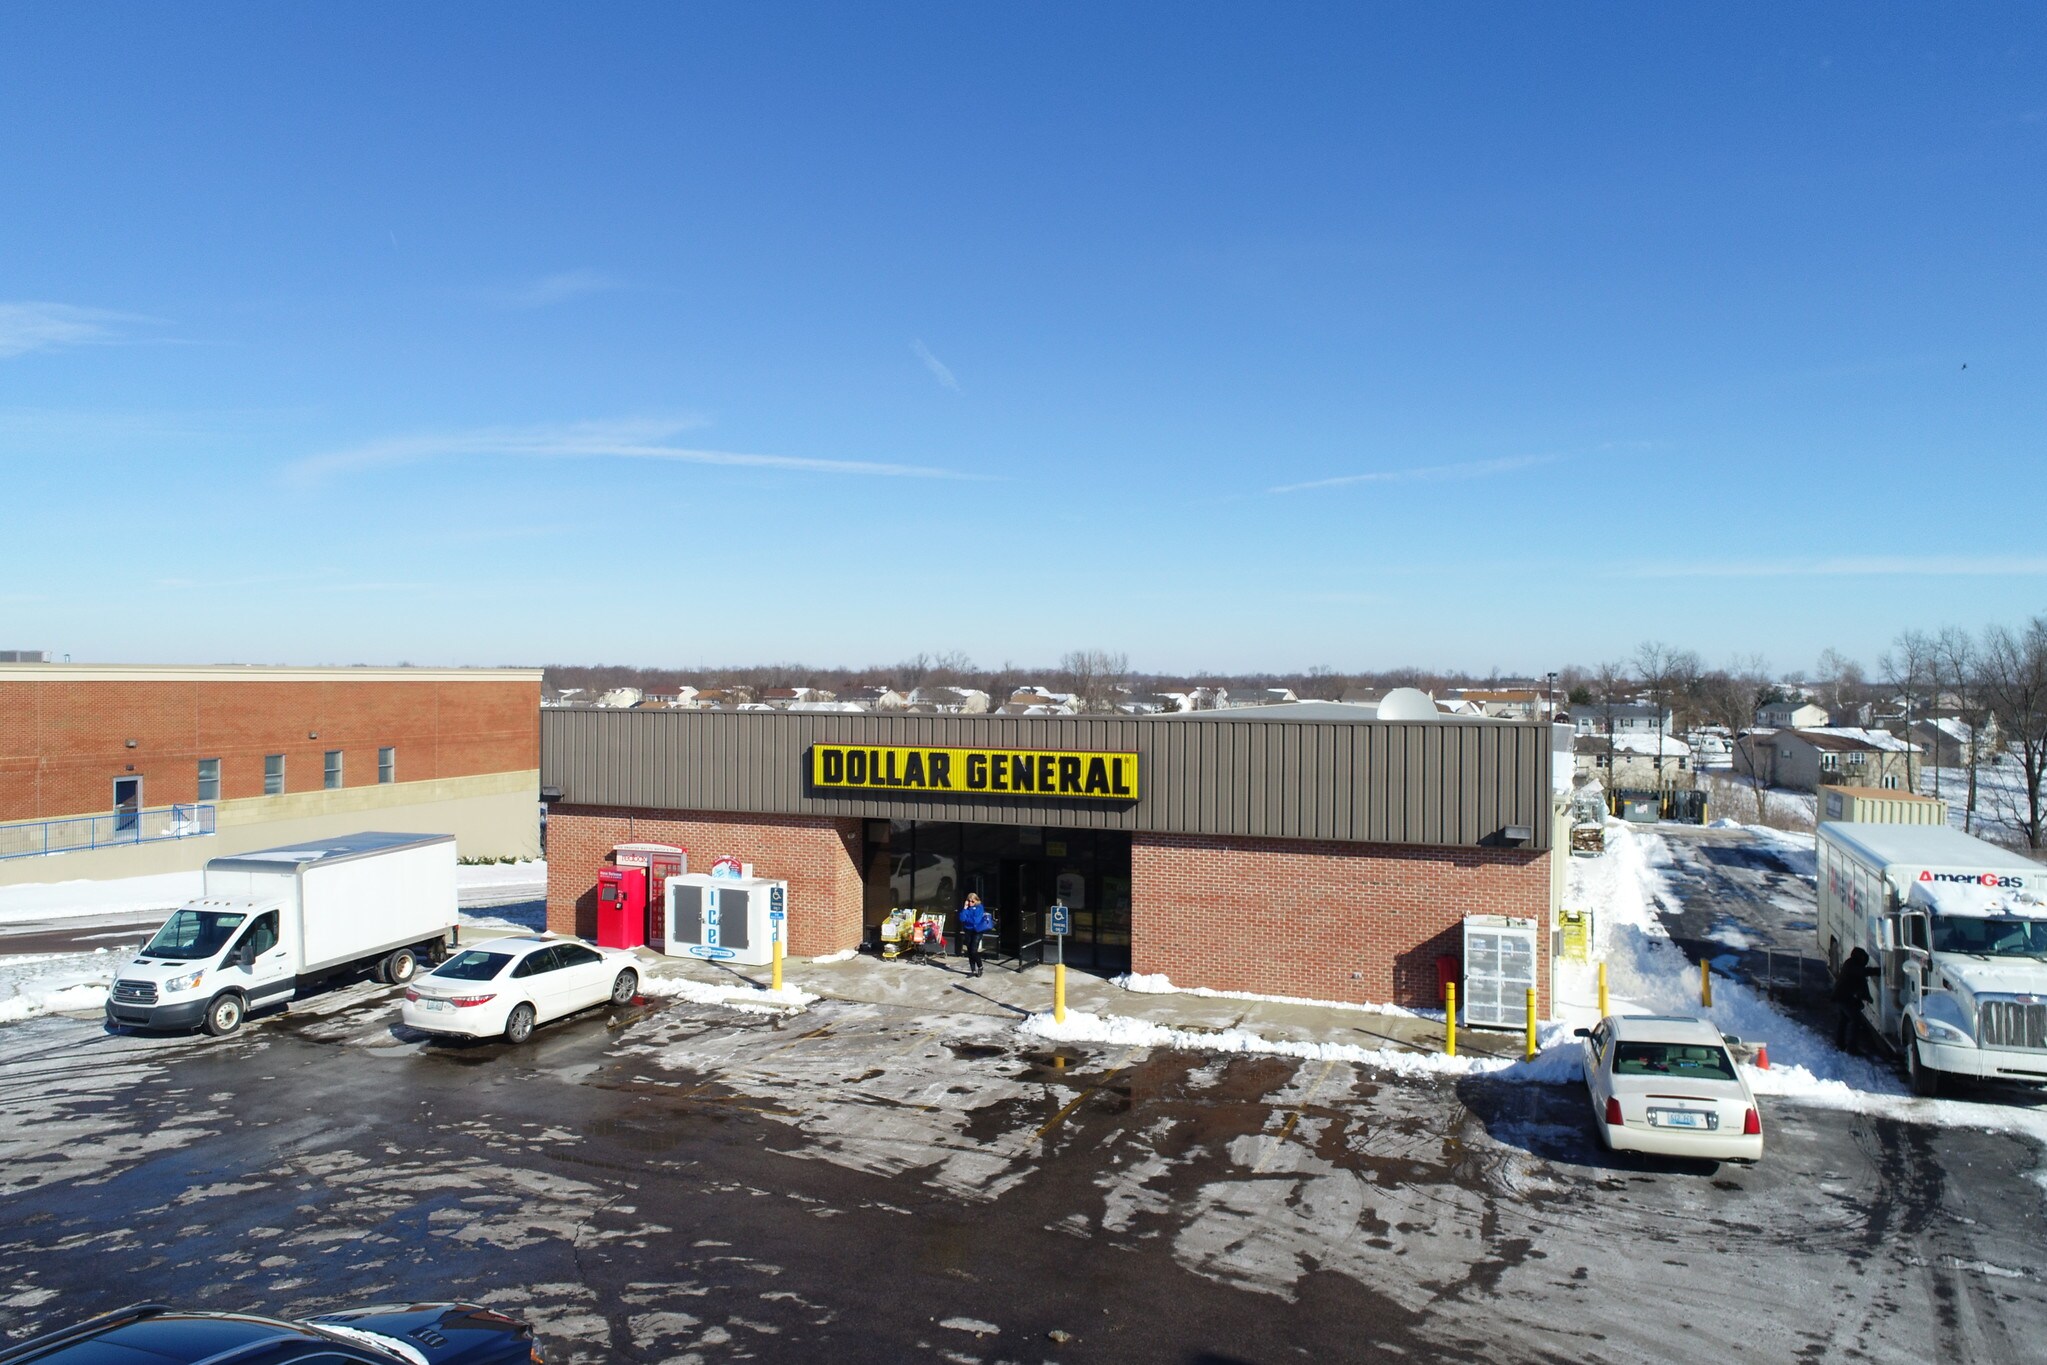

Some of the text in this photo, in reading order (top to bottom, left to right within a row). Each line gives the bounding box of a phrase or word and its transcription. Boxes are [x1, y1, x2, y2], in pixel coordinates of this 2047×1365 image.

[822, 750, 1130, 795] DOLLAR GENERAL
[1919, 870, 2023, 888] AmeriGas
